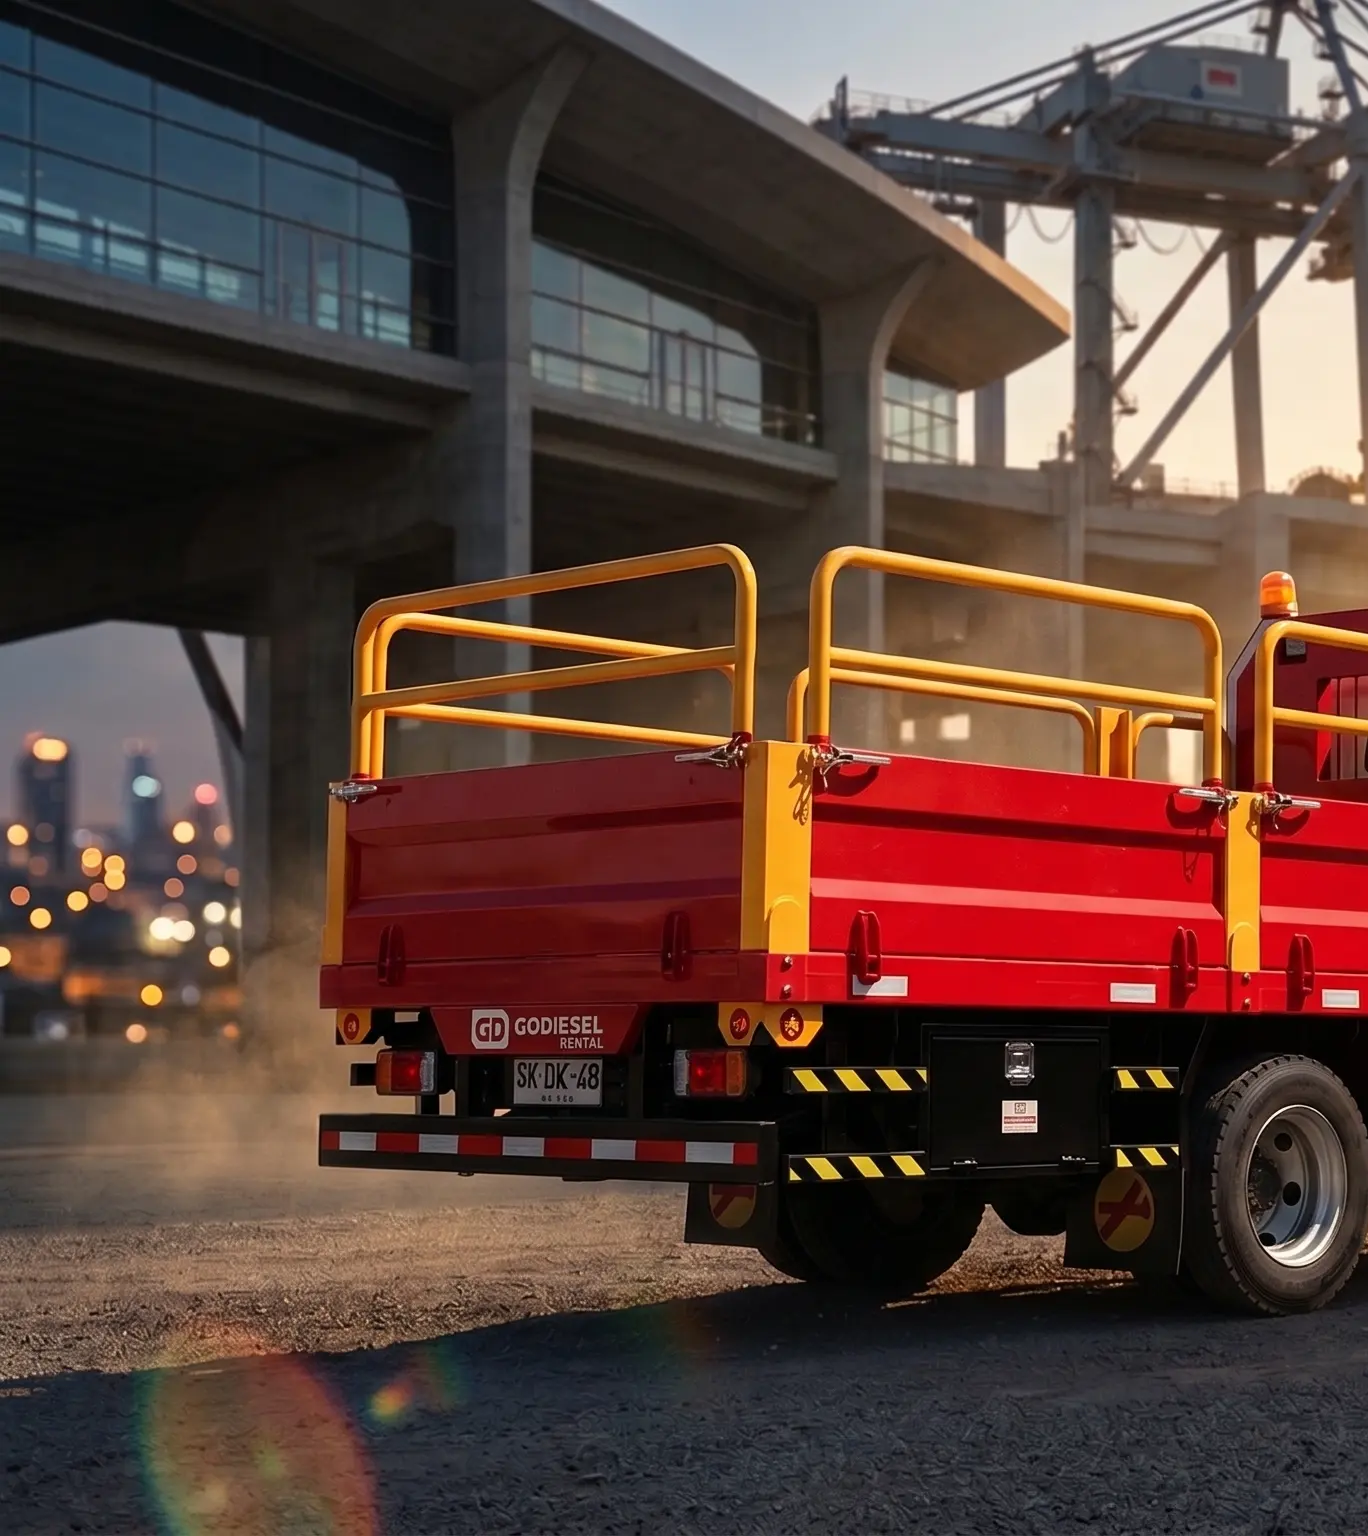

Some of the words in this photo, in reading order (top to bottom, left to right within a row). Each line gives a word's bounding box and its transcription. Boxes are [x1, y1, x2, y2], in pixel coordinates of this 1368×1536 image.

[473, 1015, 507, 1043] GD
[514, 1015, 604, 1036] GODIESEL
[559, 1036, 604, 1049] RENTAL
